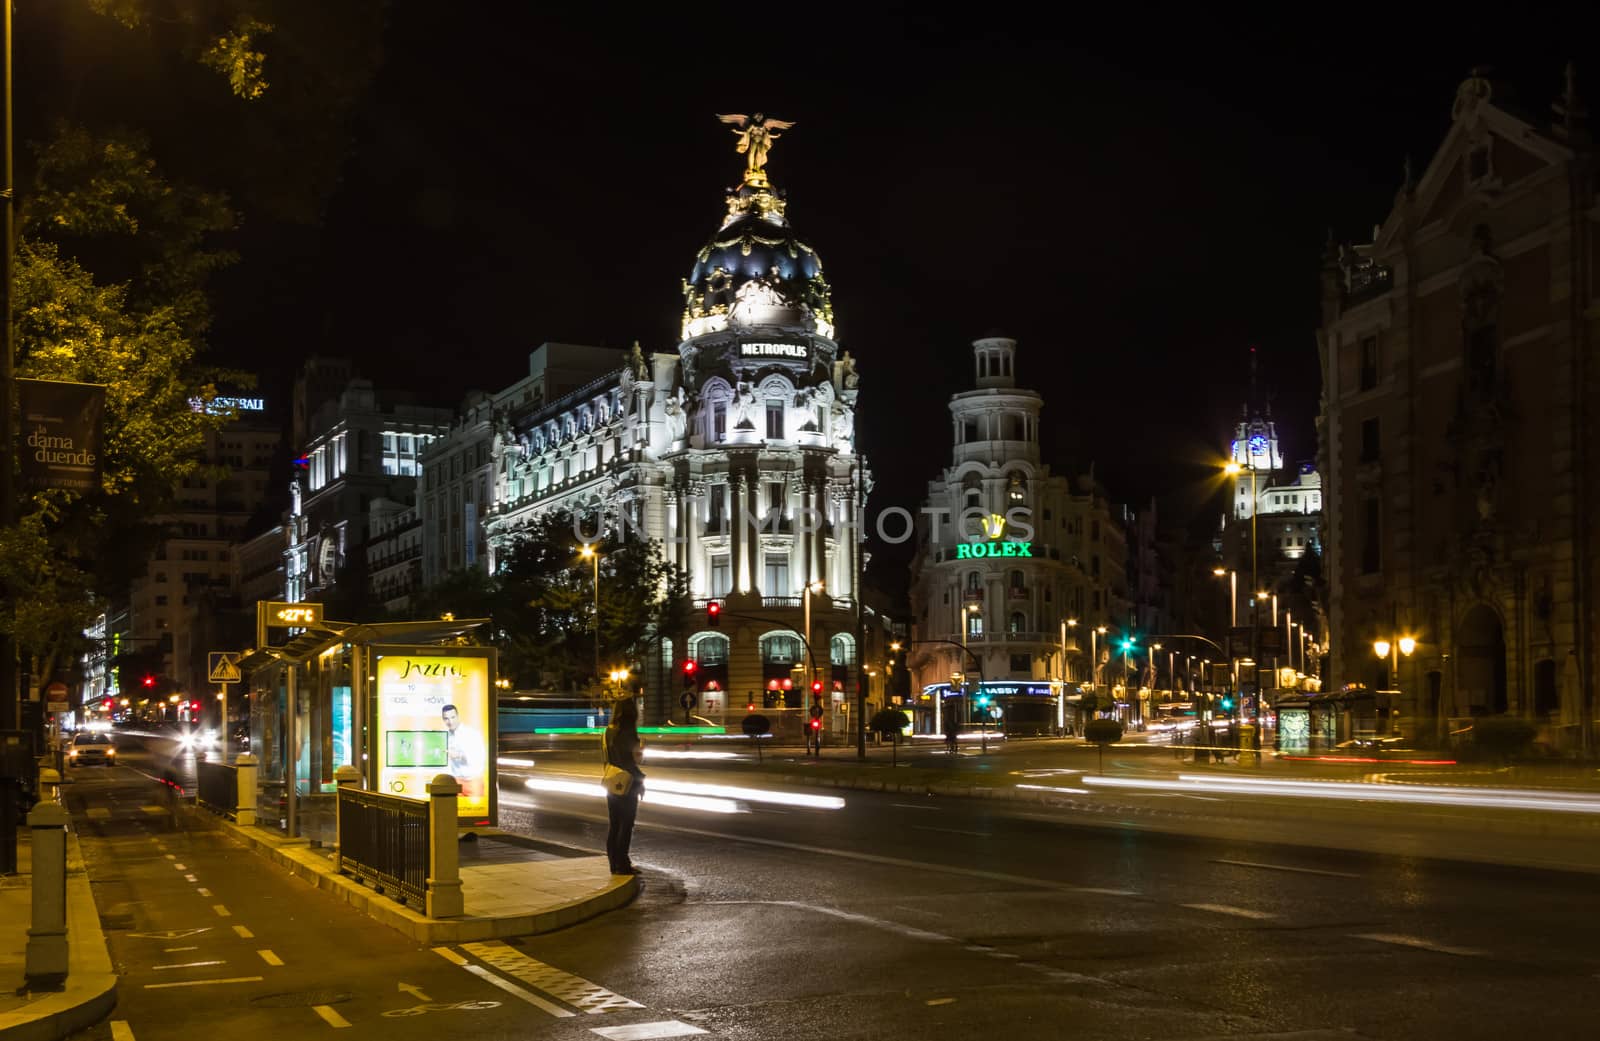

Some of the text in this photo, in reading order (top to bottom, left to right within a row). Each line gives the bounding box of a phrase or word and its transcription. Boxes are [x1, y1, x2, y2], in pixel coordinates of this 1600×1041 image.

[741, 343, 807, 357] METROPOLIS
[27, 431, 74, 449] dama
[35, 446, 96, 465] duende
[957, 541, 1033, 559] ROLEX
